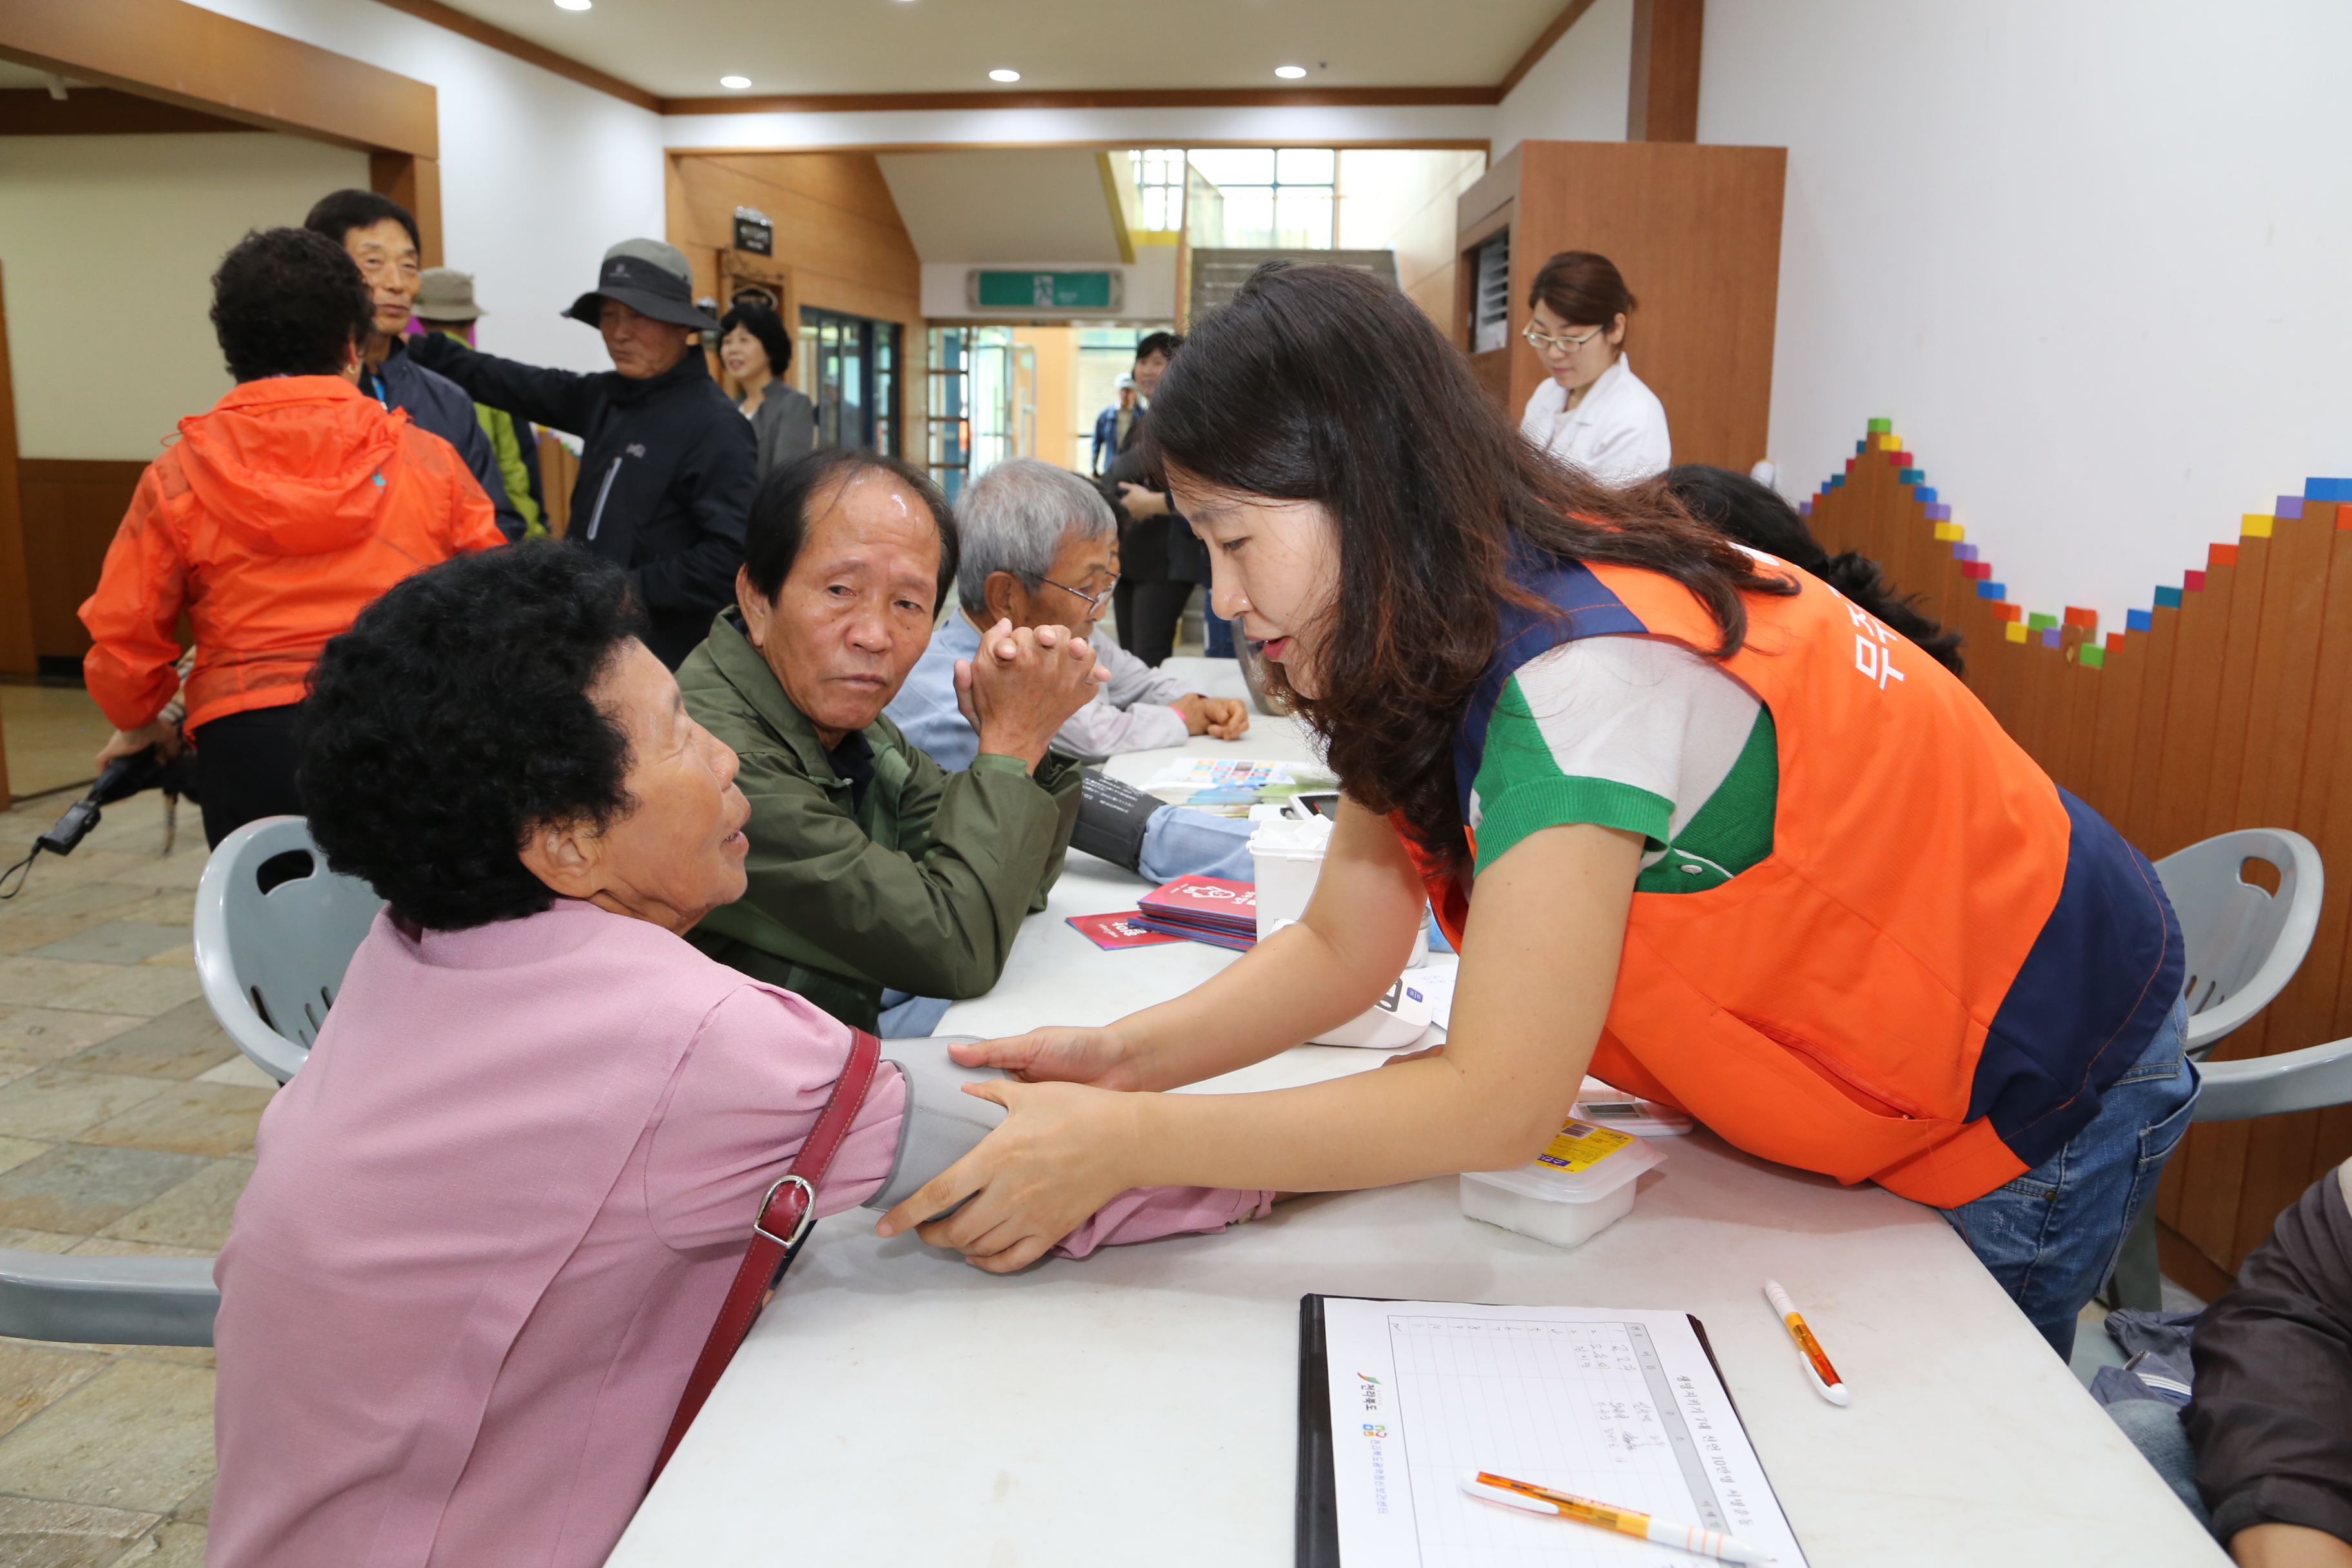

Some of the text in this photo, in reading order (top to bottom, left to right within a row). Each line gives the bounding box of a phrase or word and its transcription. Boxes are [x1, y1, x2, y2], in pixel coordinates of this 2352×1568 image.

[1825, 583, 1905, 690] 무주
[1361, 1384, 1377, 1411] 전라북도
[1677, 1375, 1705, 1413] 생명지키기
[1695, 1417, 1712, 1429] 7대
[1703, 1435, 1721, 1451] 선언
[1712, 1456, 1735, 1483] 10만명
